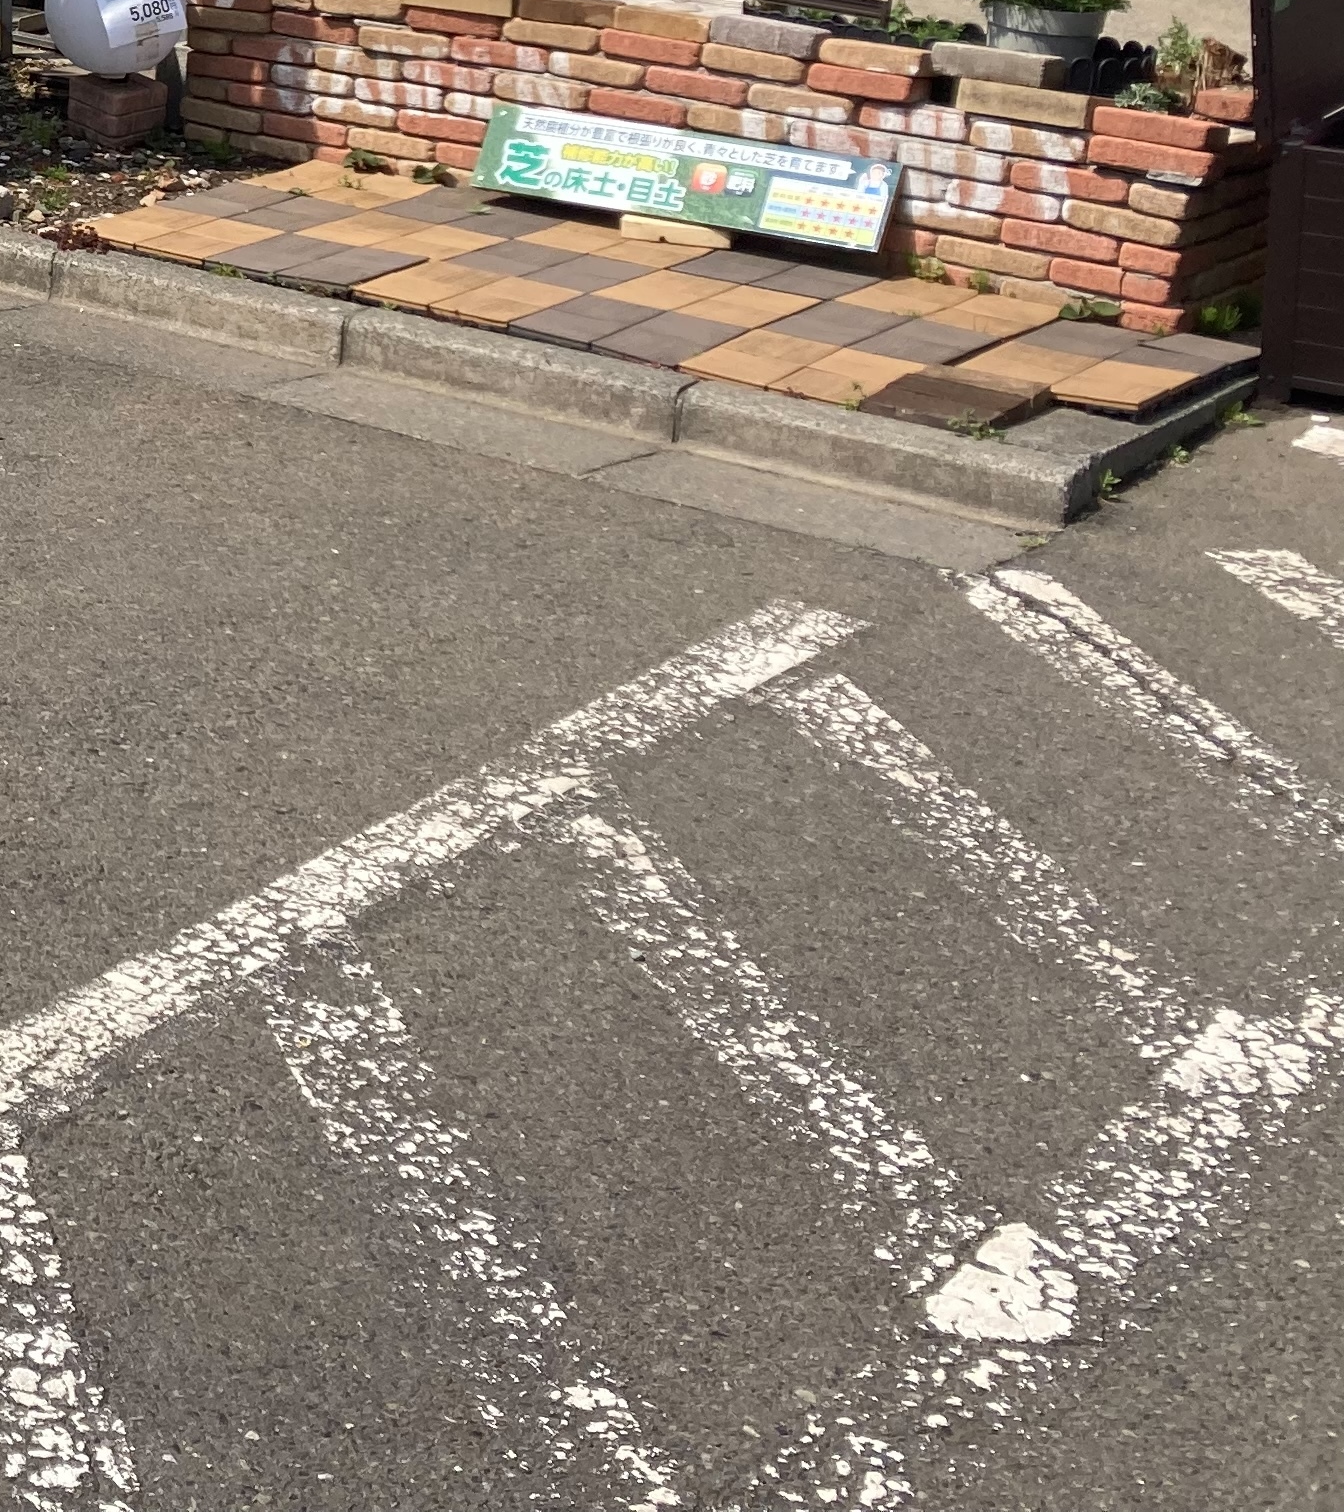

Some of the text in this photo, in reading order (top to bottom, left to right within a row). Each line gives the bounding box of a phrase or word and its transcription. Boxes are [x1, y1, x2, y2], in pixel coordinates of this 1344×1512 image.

[498, 141, 685, 212] 芝の床土・目土
